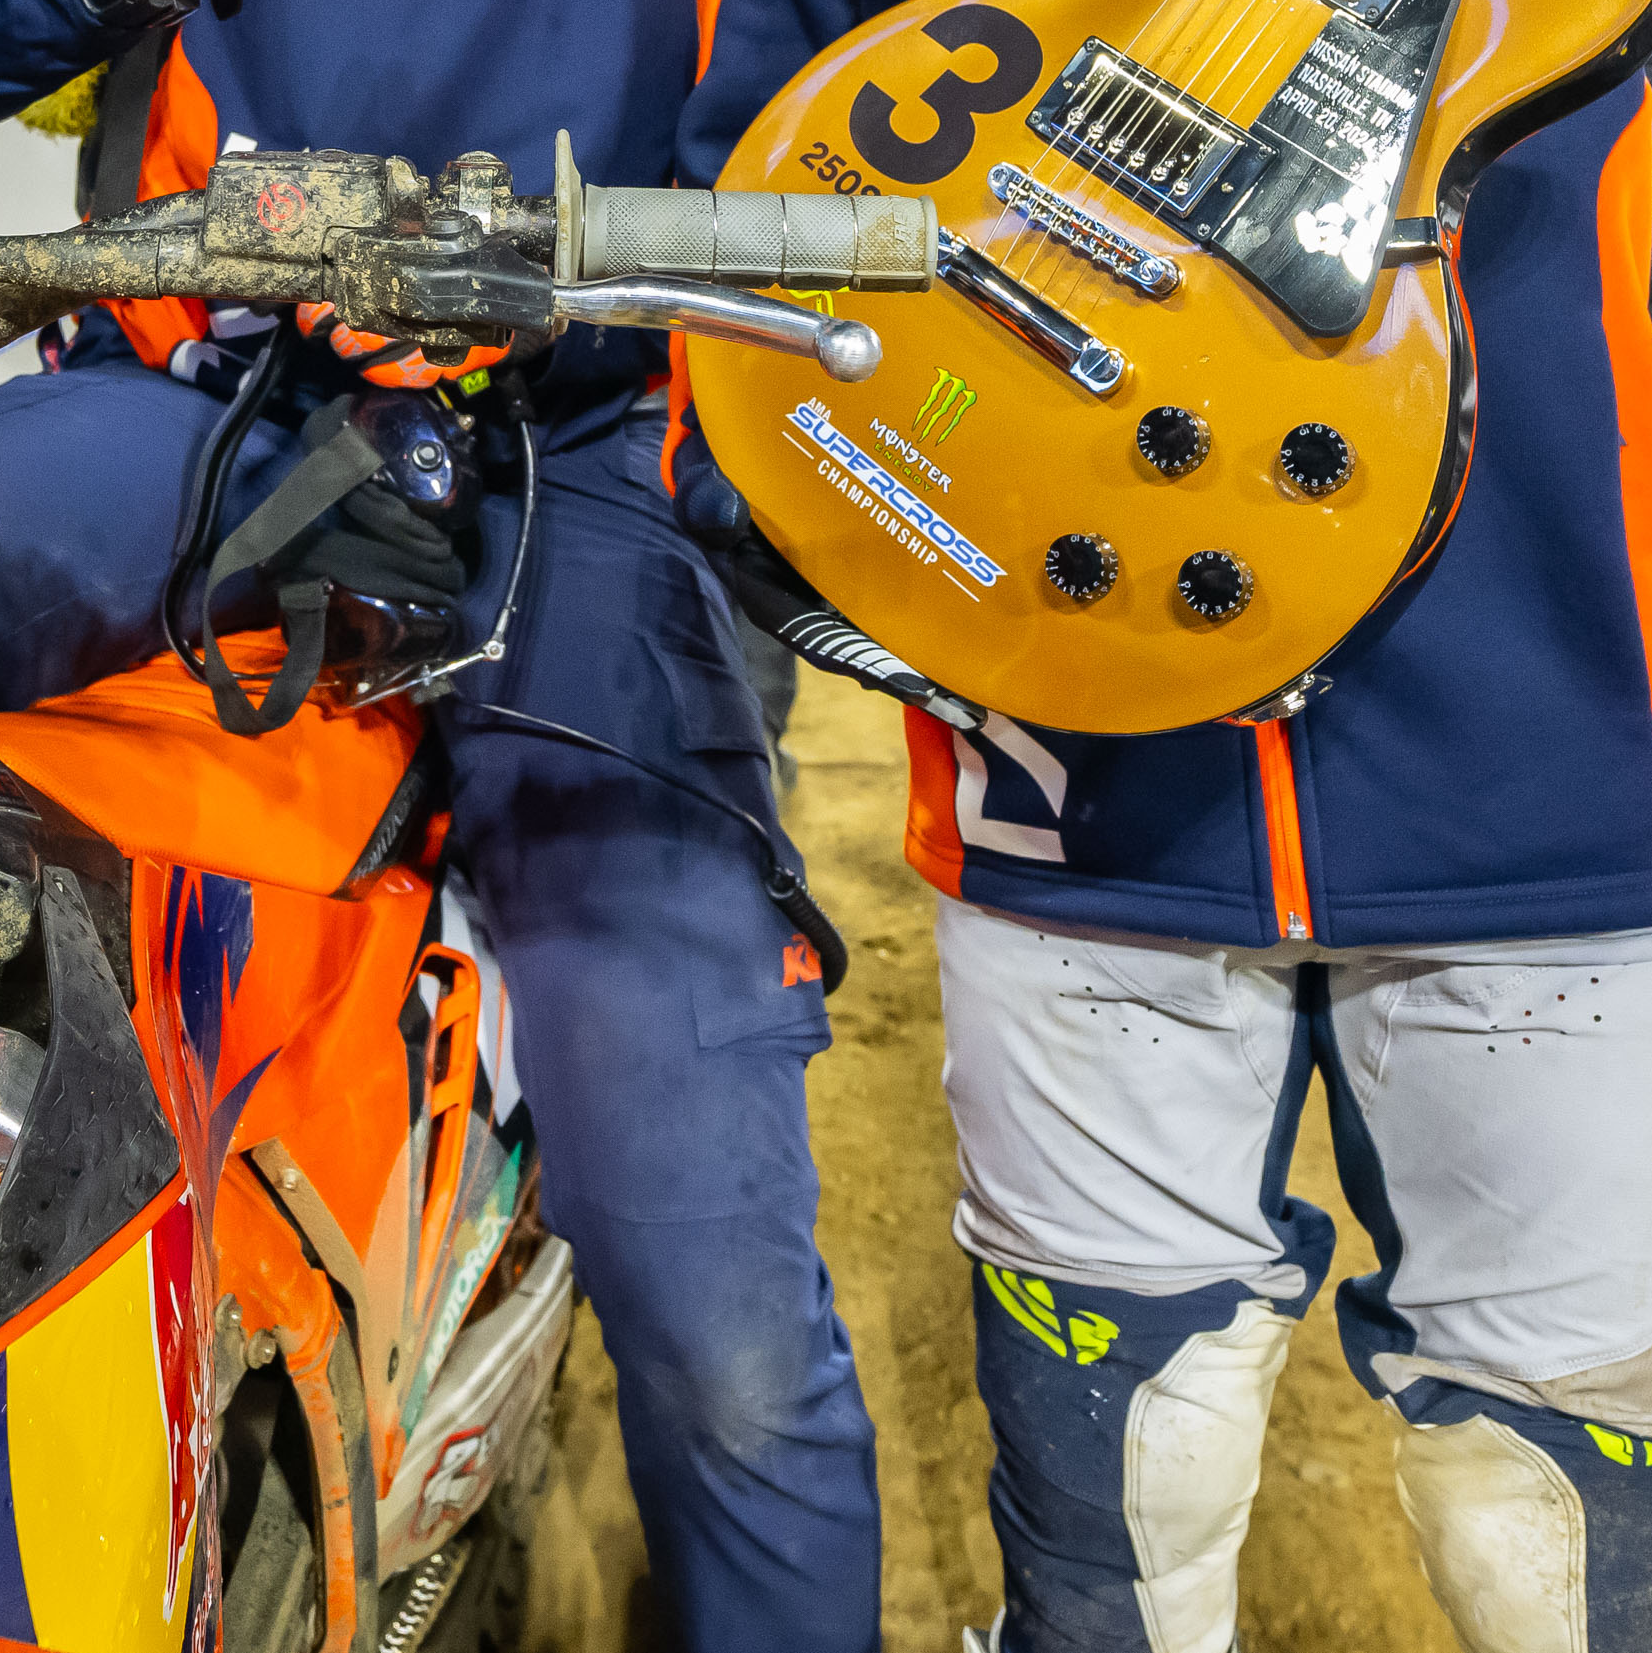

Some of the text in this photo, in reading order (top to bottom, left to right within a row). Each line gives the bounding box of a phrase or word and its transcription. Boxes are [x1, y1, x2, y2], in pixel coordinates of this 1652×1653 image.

[848, 3, 1044, 185] 3
[1277, 85, 1315, 120] APRIL
[1297, 62, 1397, 132] NASHVILLE, TN
[1308, 36, 1418, 112] NISSAN STADIUM
[806, 396, 833, 421] AMA
[869, 417, 953, 494] MONSTER
[873, 442, 934, 492] ENERGY
[787, 403, 1006, 586] SUPERCROSS
[816, 458, 939, 566] CHAMPIONSHIP
[781, 932, 823, 988] KT
